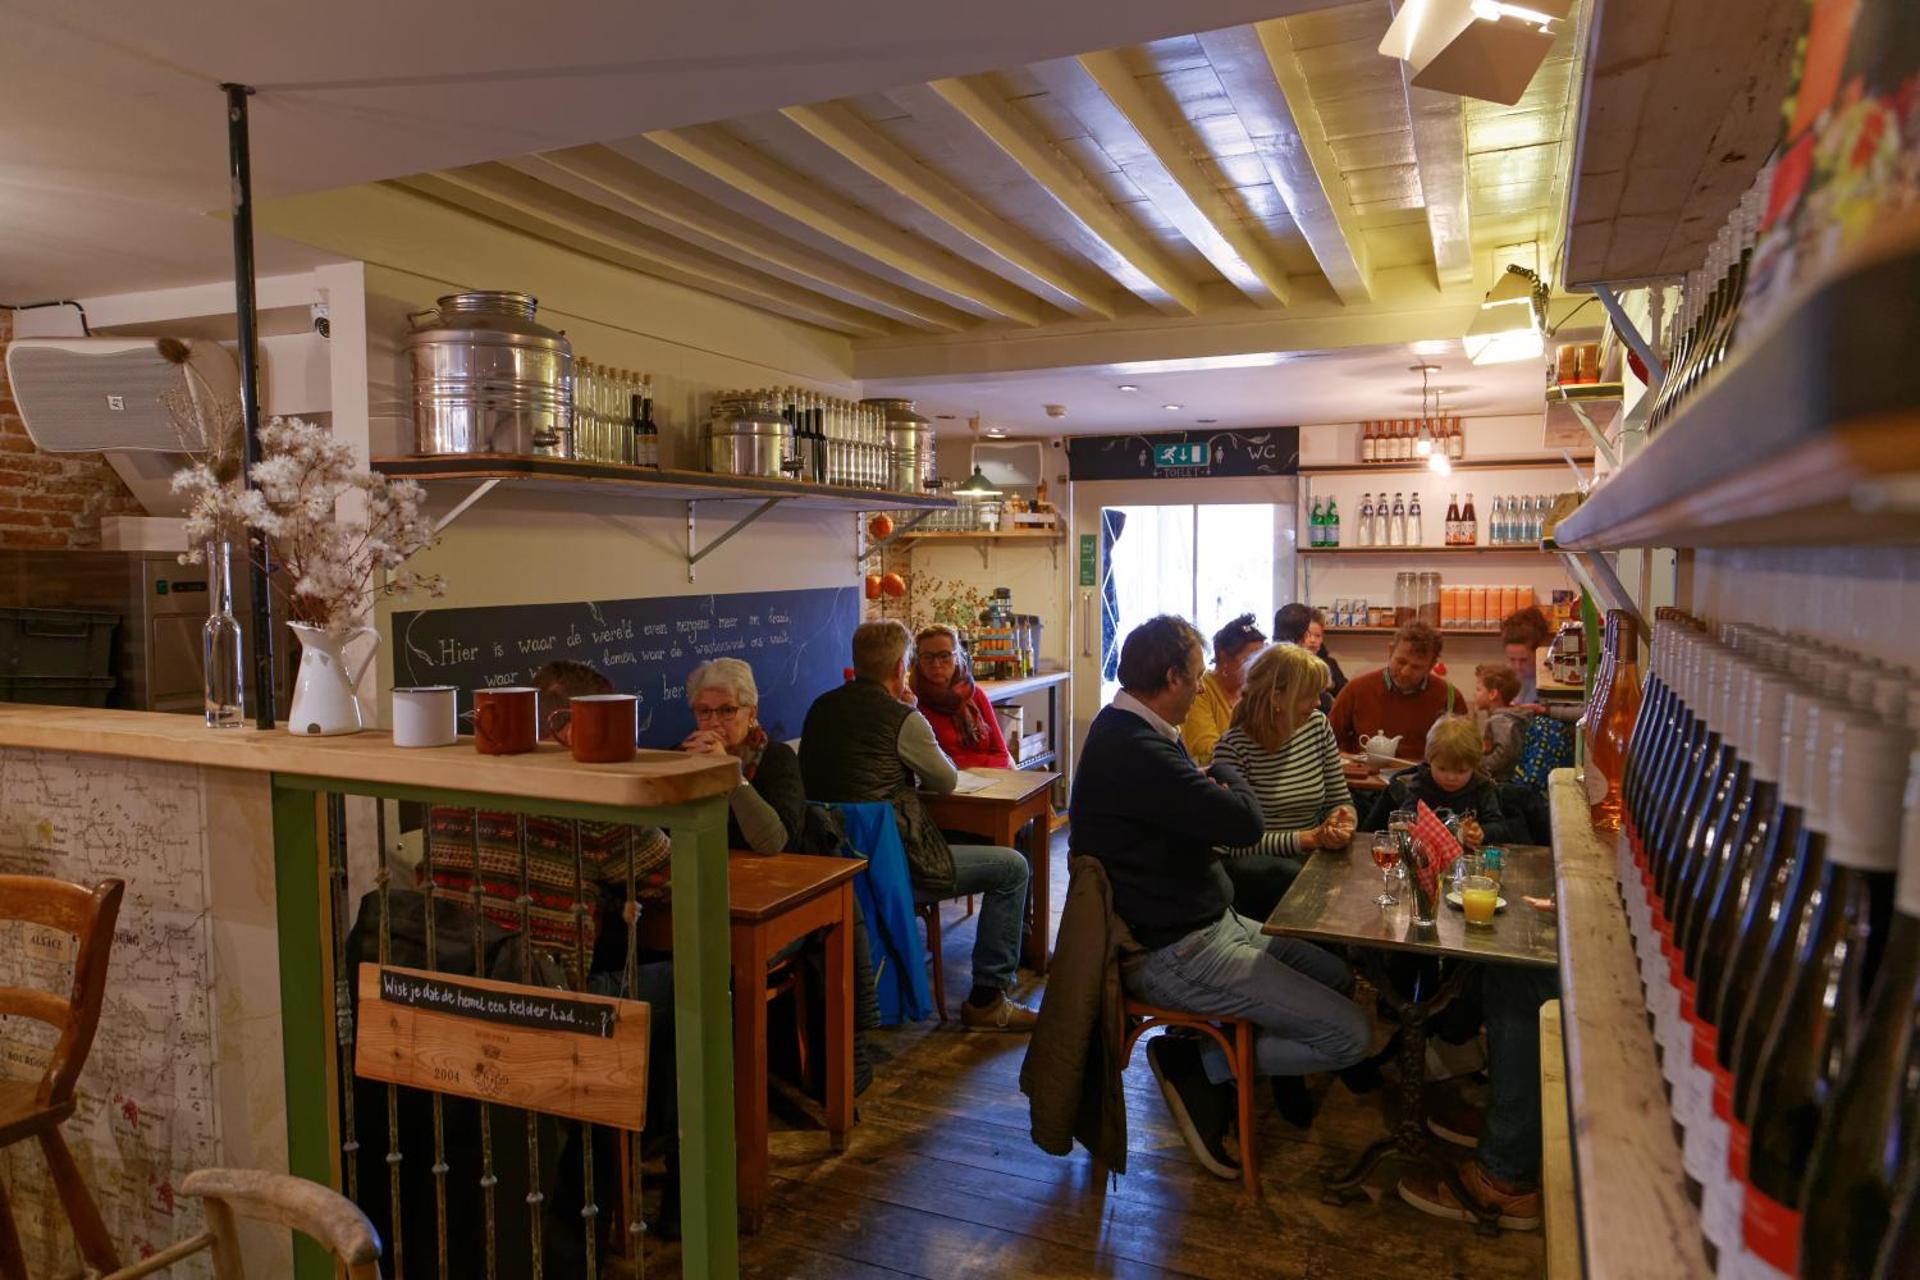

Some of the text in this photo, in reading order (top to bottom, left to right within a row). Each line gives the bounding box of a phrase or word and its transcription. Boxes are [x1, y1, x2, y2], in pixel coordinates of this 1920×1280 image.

[1247, 444, 1276, 460] WC
[439, 638, 478, 666] Hier
[494, 642, 504, 657] is
[518, 635, 557, 654] waar
[567, 624, 582, 647] de
[592, 618, 634, 644] wereld
[644, 623, 669, 636] even
[484, 671, 519, 687] waar
[641, 648, 665, 661] waar
[670, 640, 683, 658] de
[383, 974, 407, 997] Wist
[409, 983, 421, 1002] je
[423, 982, 440, 1001] dat
[441, 988, 454, 1004] de
[457, 989, 485, 1011] hemel
[488, 1000, 507, 1013] een
[509, 1000, 549, 1017] kelder
